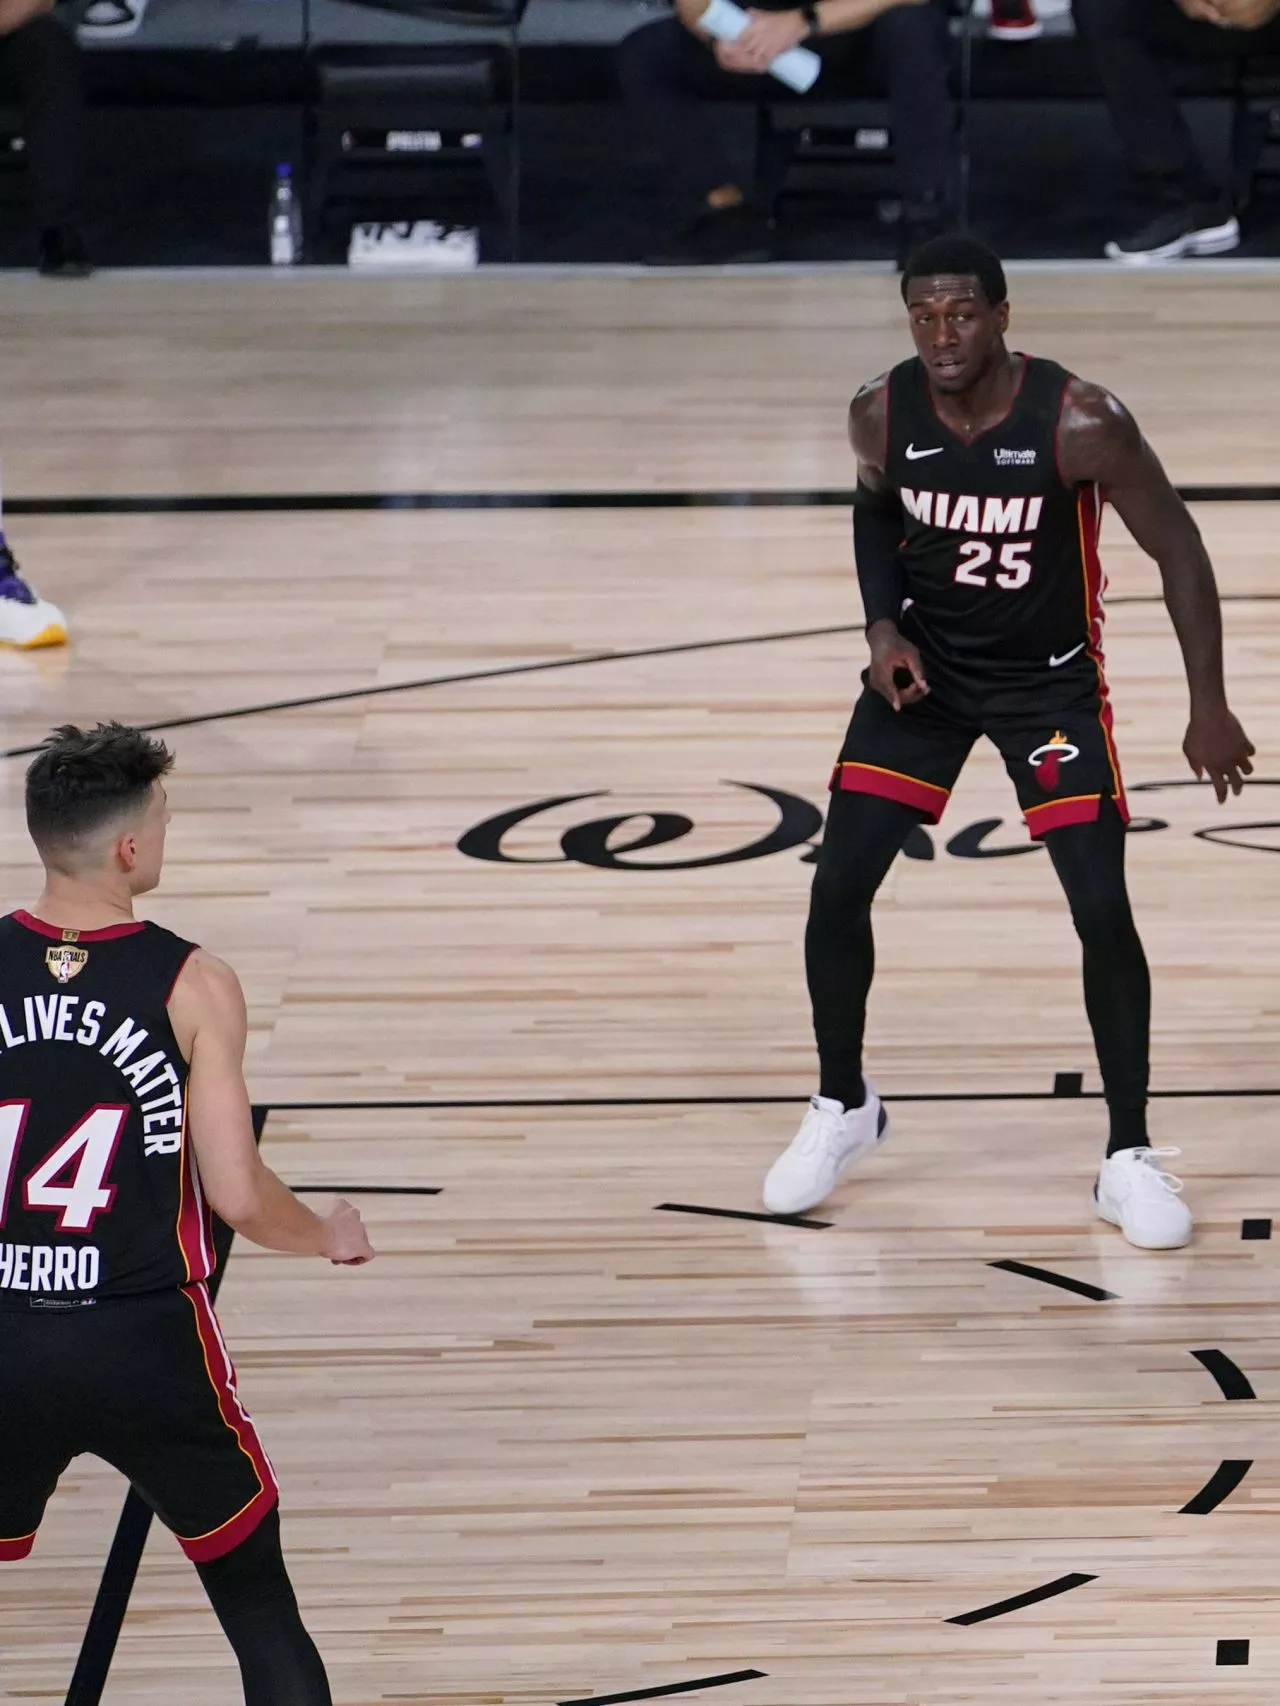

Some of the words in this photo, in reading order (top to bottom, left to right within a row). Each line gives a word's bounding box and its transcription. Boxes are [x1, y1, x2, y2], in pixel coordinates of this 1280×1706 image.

[993, 448, 1037, 459] Ultimate
[900, 487, 1044, 533] MIAMI
[954, 540, 1032, 589] 25
[0, 993, 105, 1048] LIVES
[99, 1017, 182, 1157] MATTER
[0, 1243, 100, 1291] HERRO
